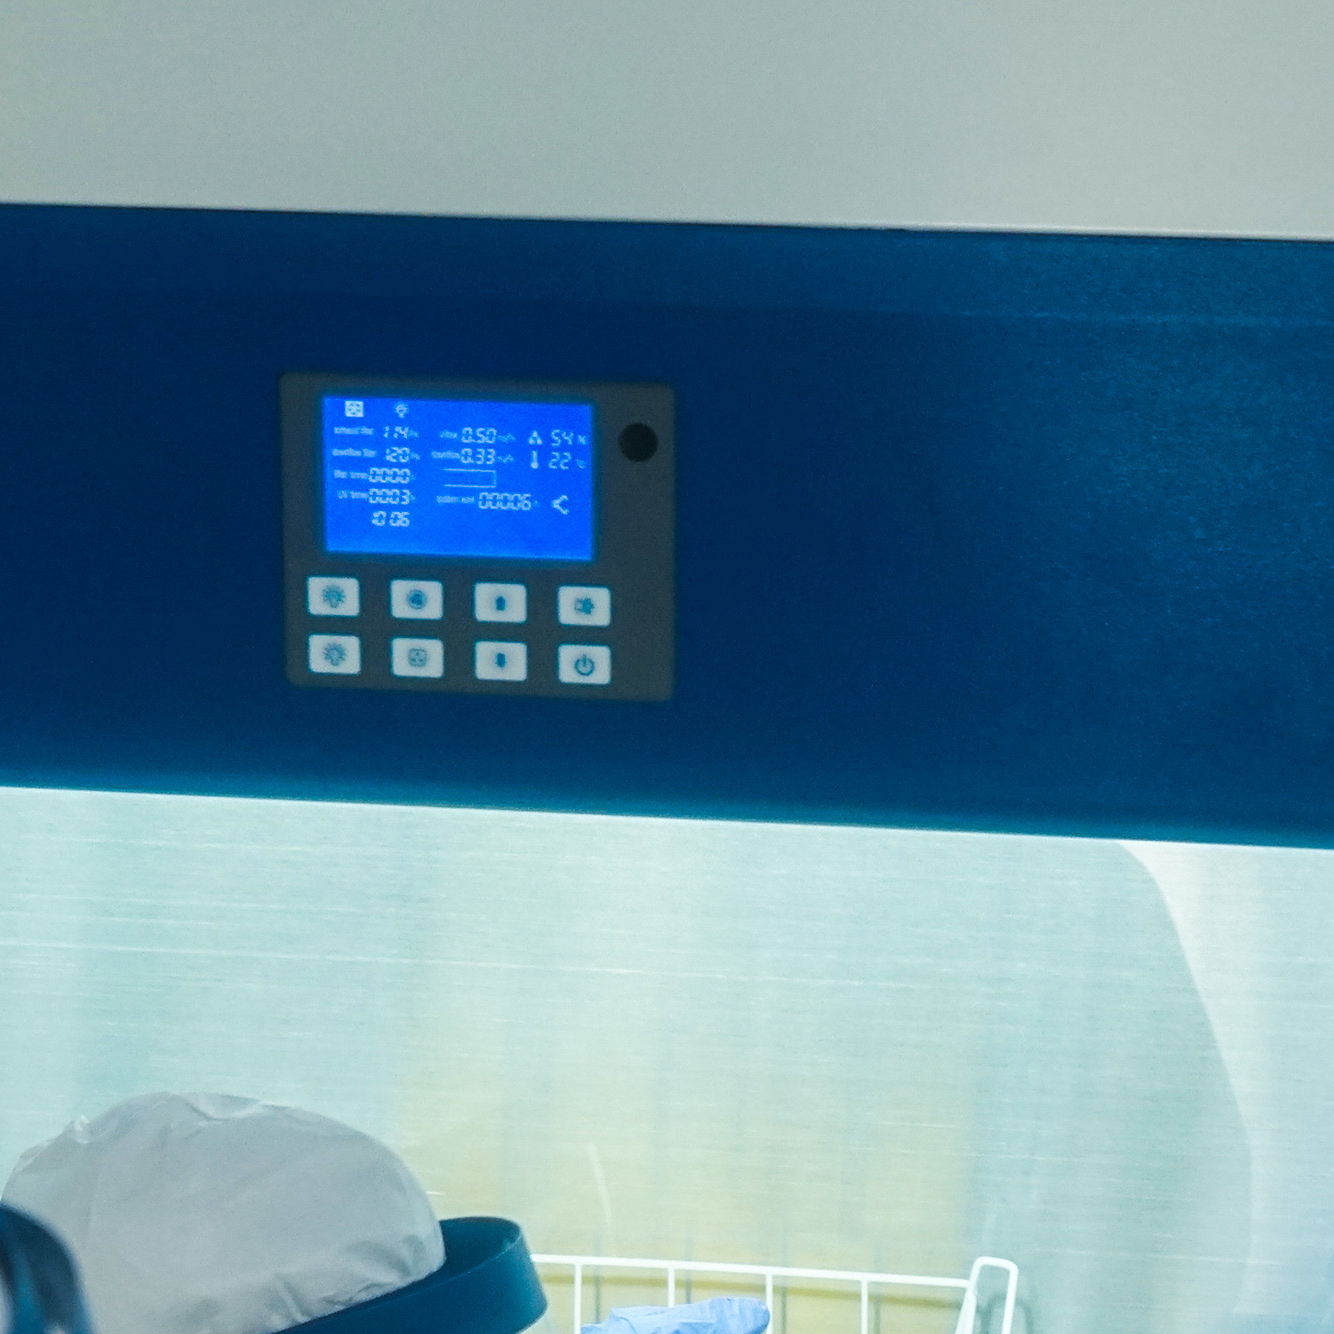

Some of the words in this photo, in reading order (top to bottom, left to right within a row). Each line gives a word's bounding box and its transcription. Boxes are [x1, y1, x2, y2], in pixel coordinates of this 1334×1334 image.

[551, 428, 574, 447] 54
[548, 451, 572, 470] 22
[368, 467, 410, 484] 0000
[368, 488, 410, 505] 0003
[478, 491, 532, 510] 00006
